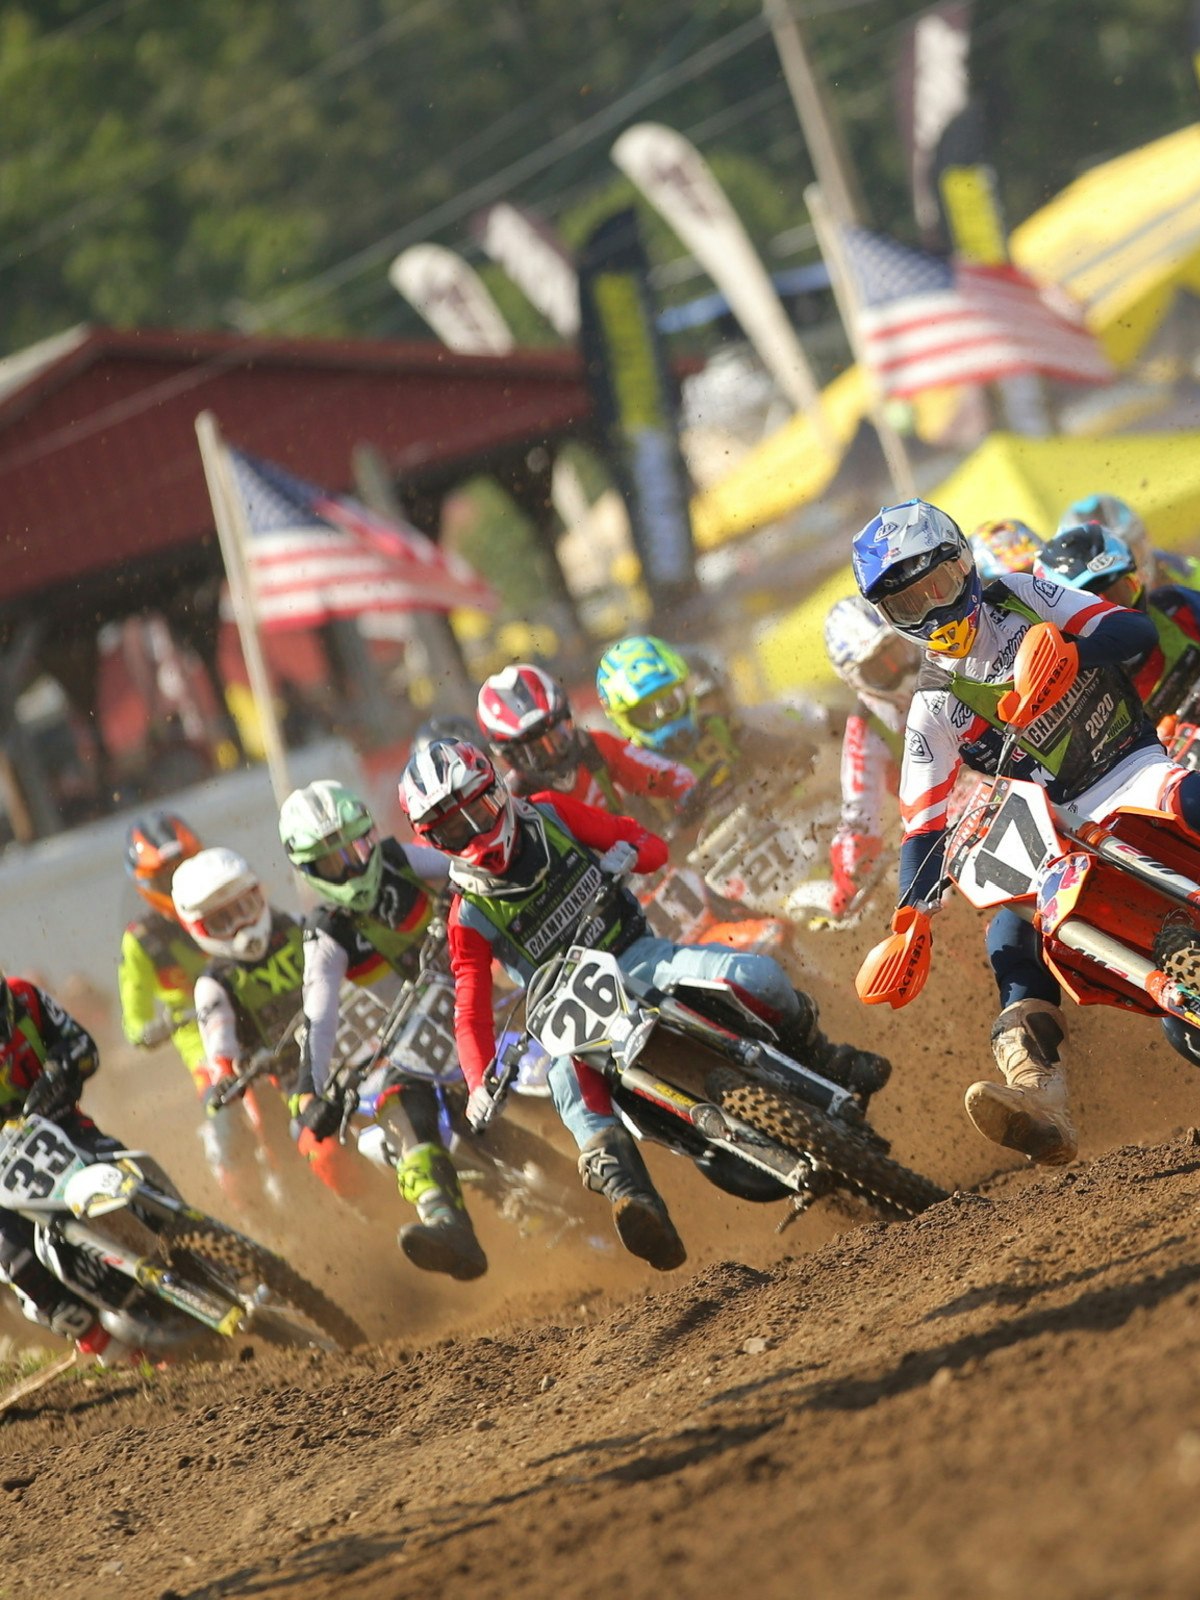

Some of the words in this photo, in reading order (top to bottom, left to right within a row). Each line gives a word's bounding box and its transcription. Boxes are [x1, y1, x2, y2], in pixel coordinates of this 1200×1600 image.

[1030, 655, 1069, 717] ACERBIS
[1084, 692, 1115, 740] 2020
[974, 792, 1048, 897] 17
[528, 866, 600, 956] CHAMPIONSHIP
[897, 934, 927, 999] ACERBIS
[550, 962, 619, 1049] 26
[2, 1128, 78, 1200] 33
